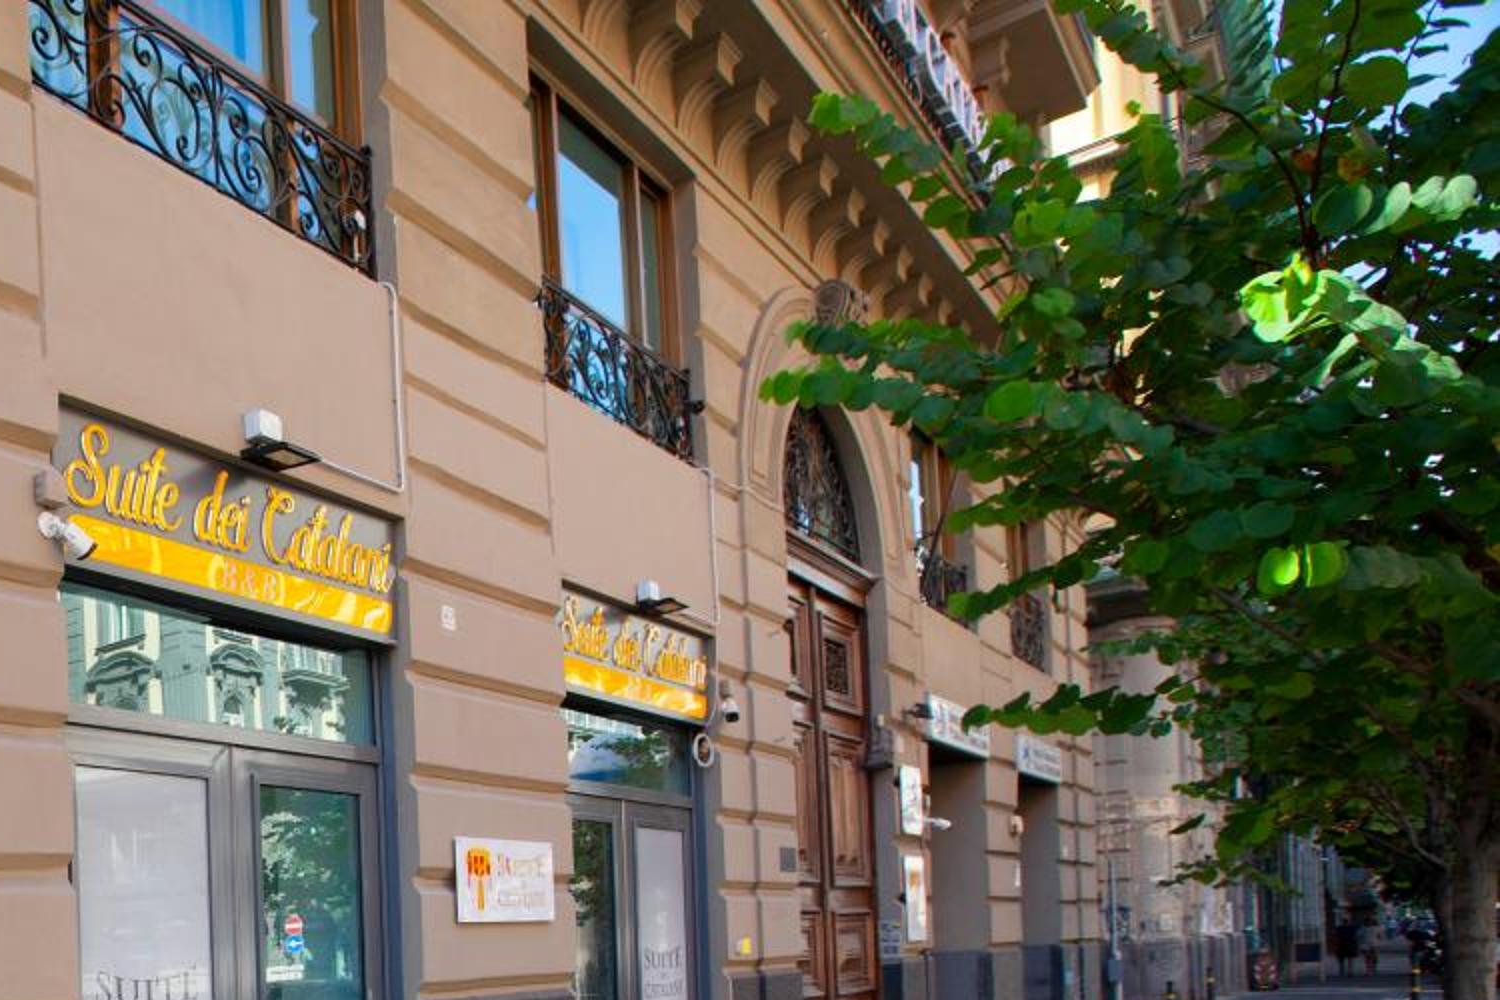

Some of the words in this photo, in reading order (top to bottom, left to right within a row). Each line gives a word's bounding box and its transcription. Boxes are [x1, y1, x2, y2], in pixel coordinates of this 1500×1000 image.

[64, 422, 184, 532] Suite
[193, 469, 251, 553] dei
[262, 485, 395, 593] Catalani
